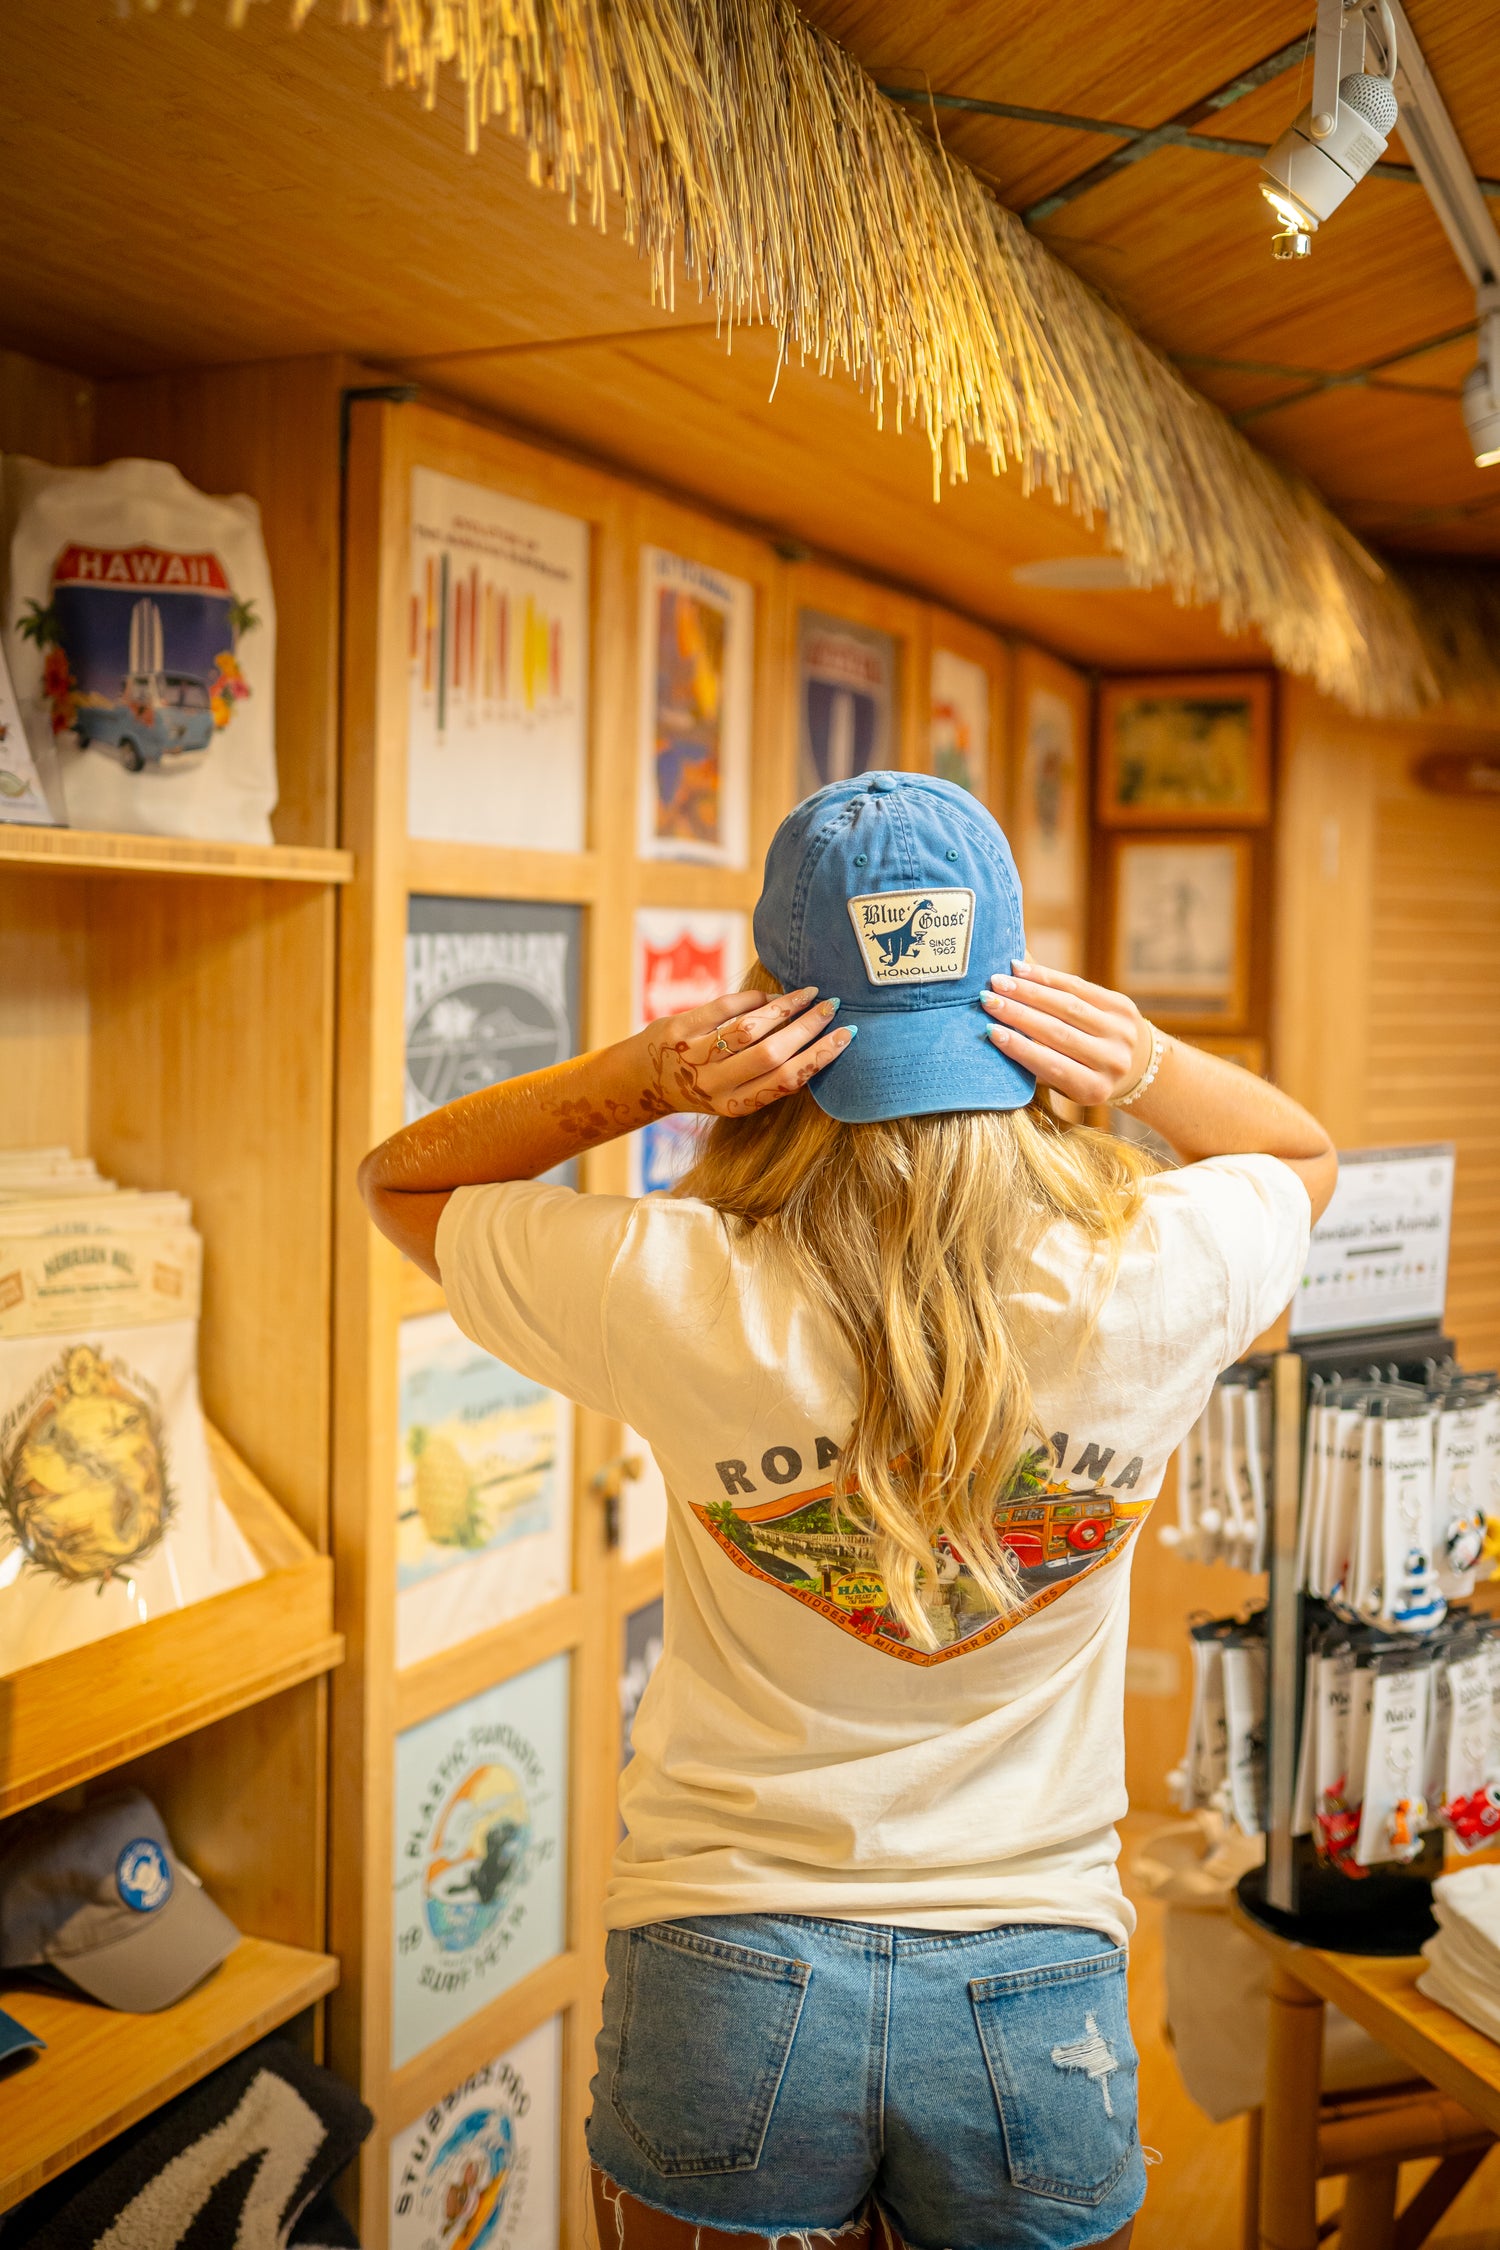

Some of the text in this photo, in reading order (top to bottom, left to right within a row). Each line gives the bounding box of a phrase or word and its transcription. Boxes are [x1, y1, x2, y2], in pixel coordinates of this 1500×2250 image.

[77, 551, 210, 584] HAWAII
[862, 904, 965, 929] Blue Goose
[929, 938, 956, 948] SINCE
[933, 946, 956, 955] 1962
[877, 964, 957, 977] HONOLULU
[715, 1431, 1143, 1495] ROA ANA
[722, 1541, 746, 1567] ONE
[789, 1586, 847, 1625] BRIDGES
[874, 1637, 915, 1660] MILES
[944, 1639, 980, 1658] OVER
[983, 1622, 1006, 1641] 600
